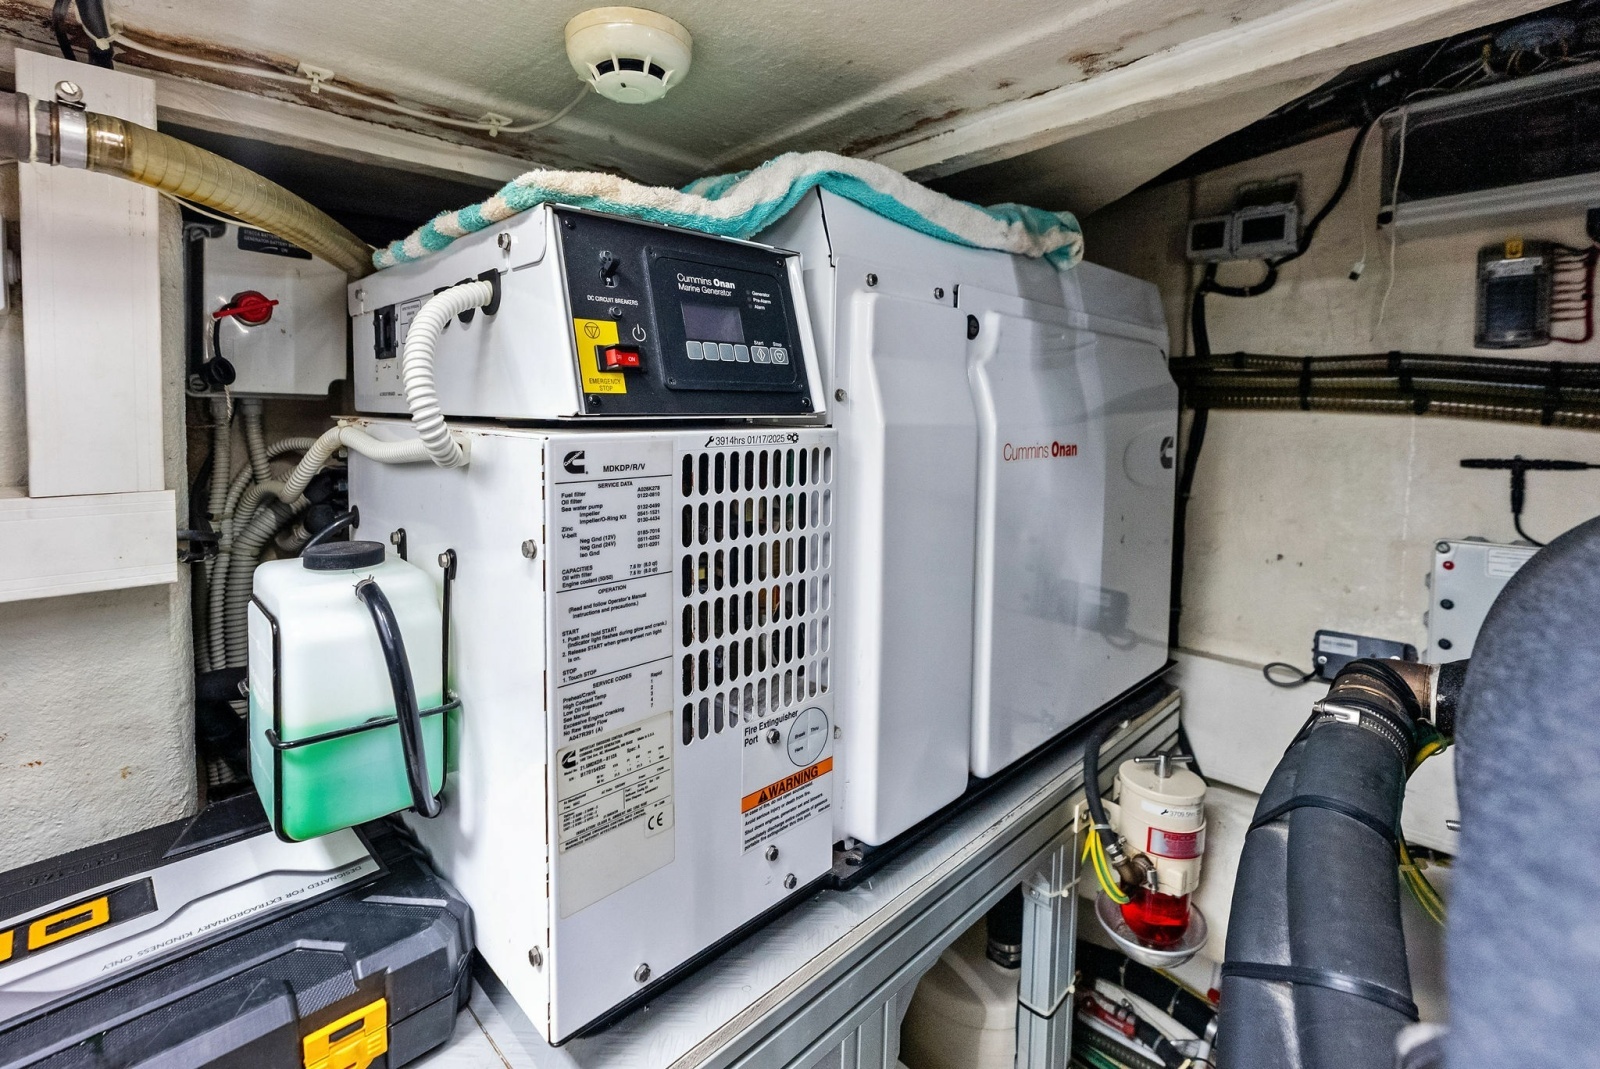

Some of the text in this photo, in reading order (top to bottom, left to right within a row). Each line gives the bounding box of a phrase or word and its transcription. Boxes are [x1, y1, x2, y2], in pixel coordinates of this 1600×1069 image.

[677, 273, 735, 289] Cummins Onan
[678, 283, 732, 296] Marine Generator
[715, 434, 785, 446] 3914hrs 01/17/2025
[1003, 441, 1078, 462] Cummins Onan
[603, 463, 646, 472] MDKDP/R/V
[562, 565, 593, 575] CAPACITIES
[598, 585, 626, 594] OPERATION
[608, 596, 631, 605] Operator's
[573, 610, 600, 618] instructions
[562, 628, 579, 637] START
[568, 639, 590, 649] (Indicator
[602, 632, 618, 641] flashes
[568, 646, 586, 656] Release
[588, 643, 603, 651] START
[562, 668, 577, 676] STOP
[584, 669, 597, 677] STOP
[592, 673, 632, 688] SERVICE CODES
[563, 690, 596, 703] Preheat/Crank
[563, 702, 574, 710] High
[575, 697, 593, 707] Coolant
[582, 701, 602, 711] Pressure
[563, 707, 624, 730] Excessive Engine Cranking
[573, 711, 590, 720] Manual
[583, 722, 596, 731] Water
[745, 710, 798, 737] Fire Extinguisher
[745, 735, 758, 747] Port
[768, 766, 818, 799] WARNING
[781, 806, 797, 818] generator
[745, 818, 755, 826] Avoid
[757, 811, 770, 820] serious
[767, 821, 784, 832] discharge
[744, 840, 760, 851] portable
[767, 824, 788, 838] extinguisher
[102, 866, 362, 971] DESIGNATED FOR EXTRAORDINARY KINDNESS ONLY
